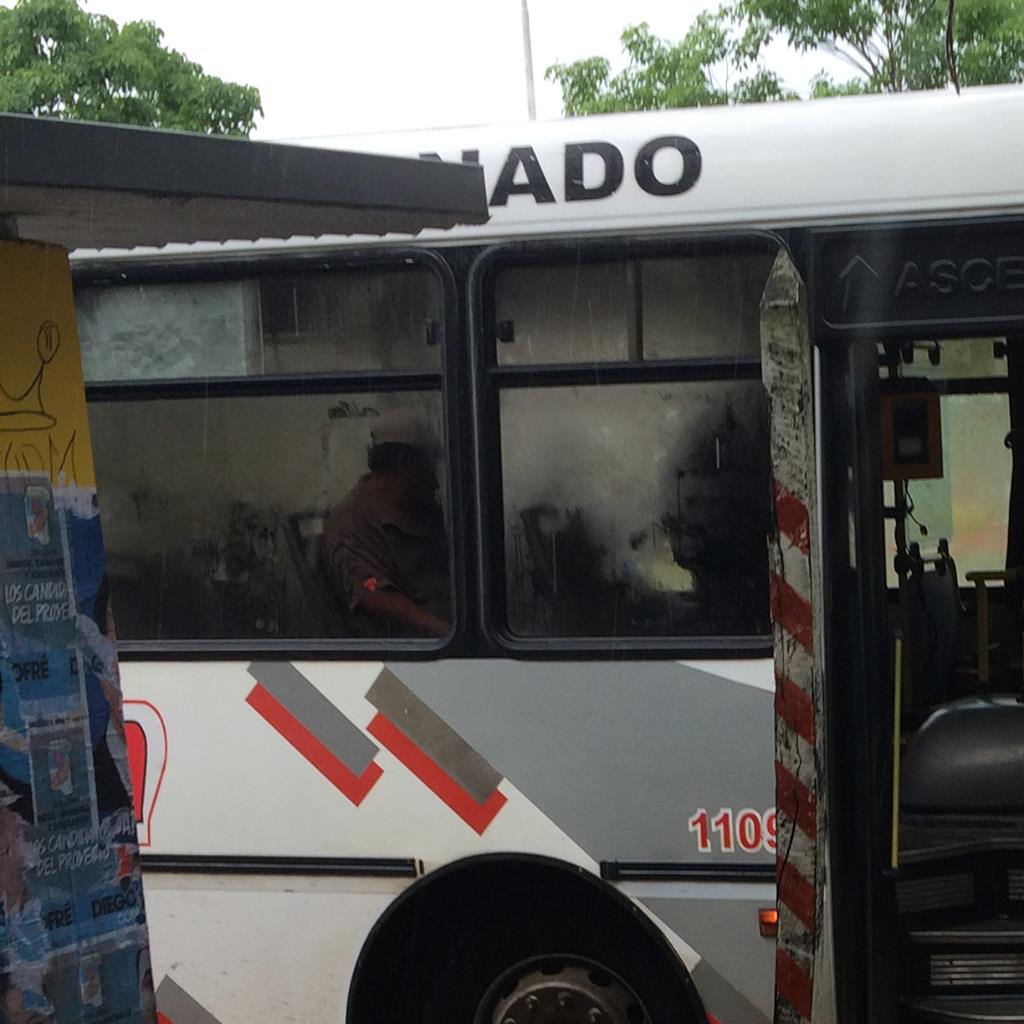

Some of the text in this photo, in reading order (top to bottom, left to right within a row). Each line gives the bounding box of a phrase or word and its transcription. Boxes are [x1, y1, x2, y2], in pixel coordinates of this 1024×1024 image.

[418, 134, 703, 207] ADO
[5, 583, 23, 604] LOS
[12, 603, 35, 625] DEL
[91, 889, 137, 919] DIEGO
